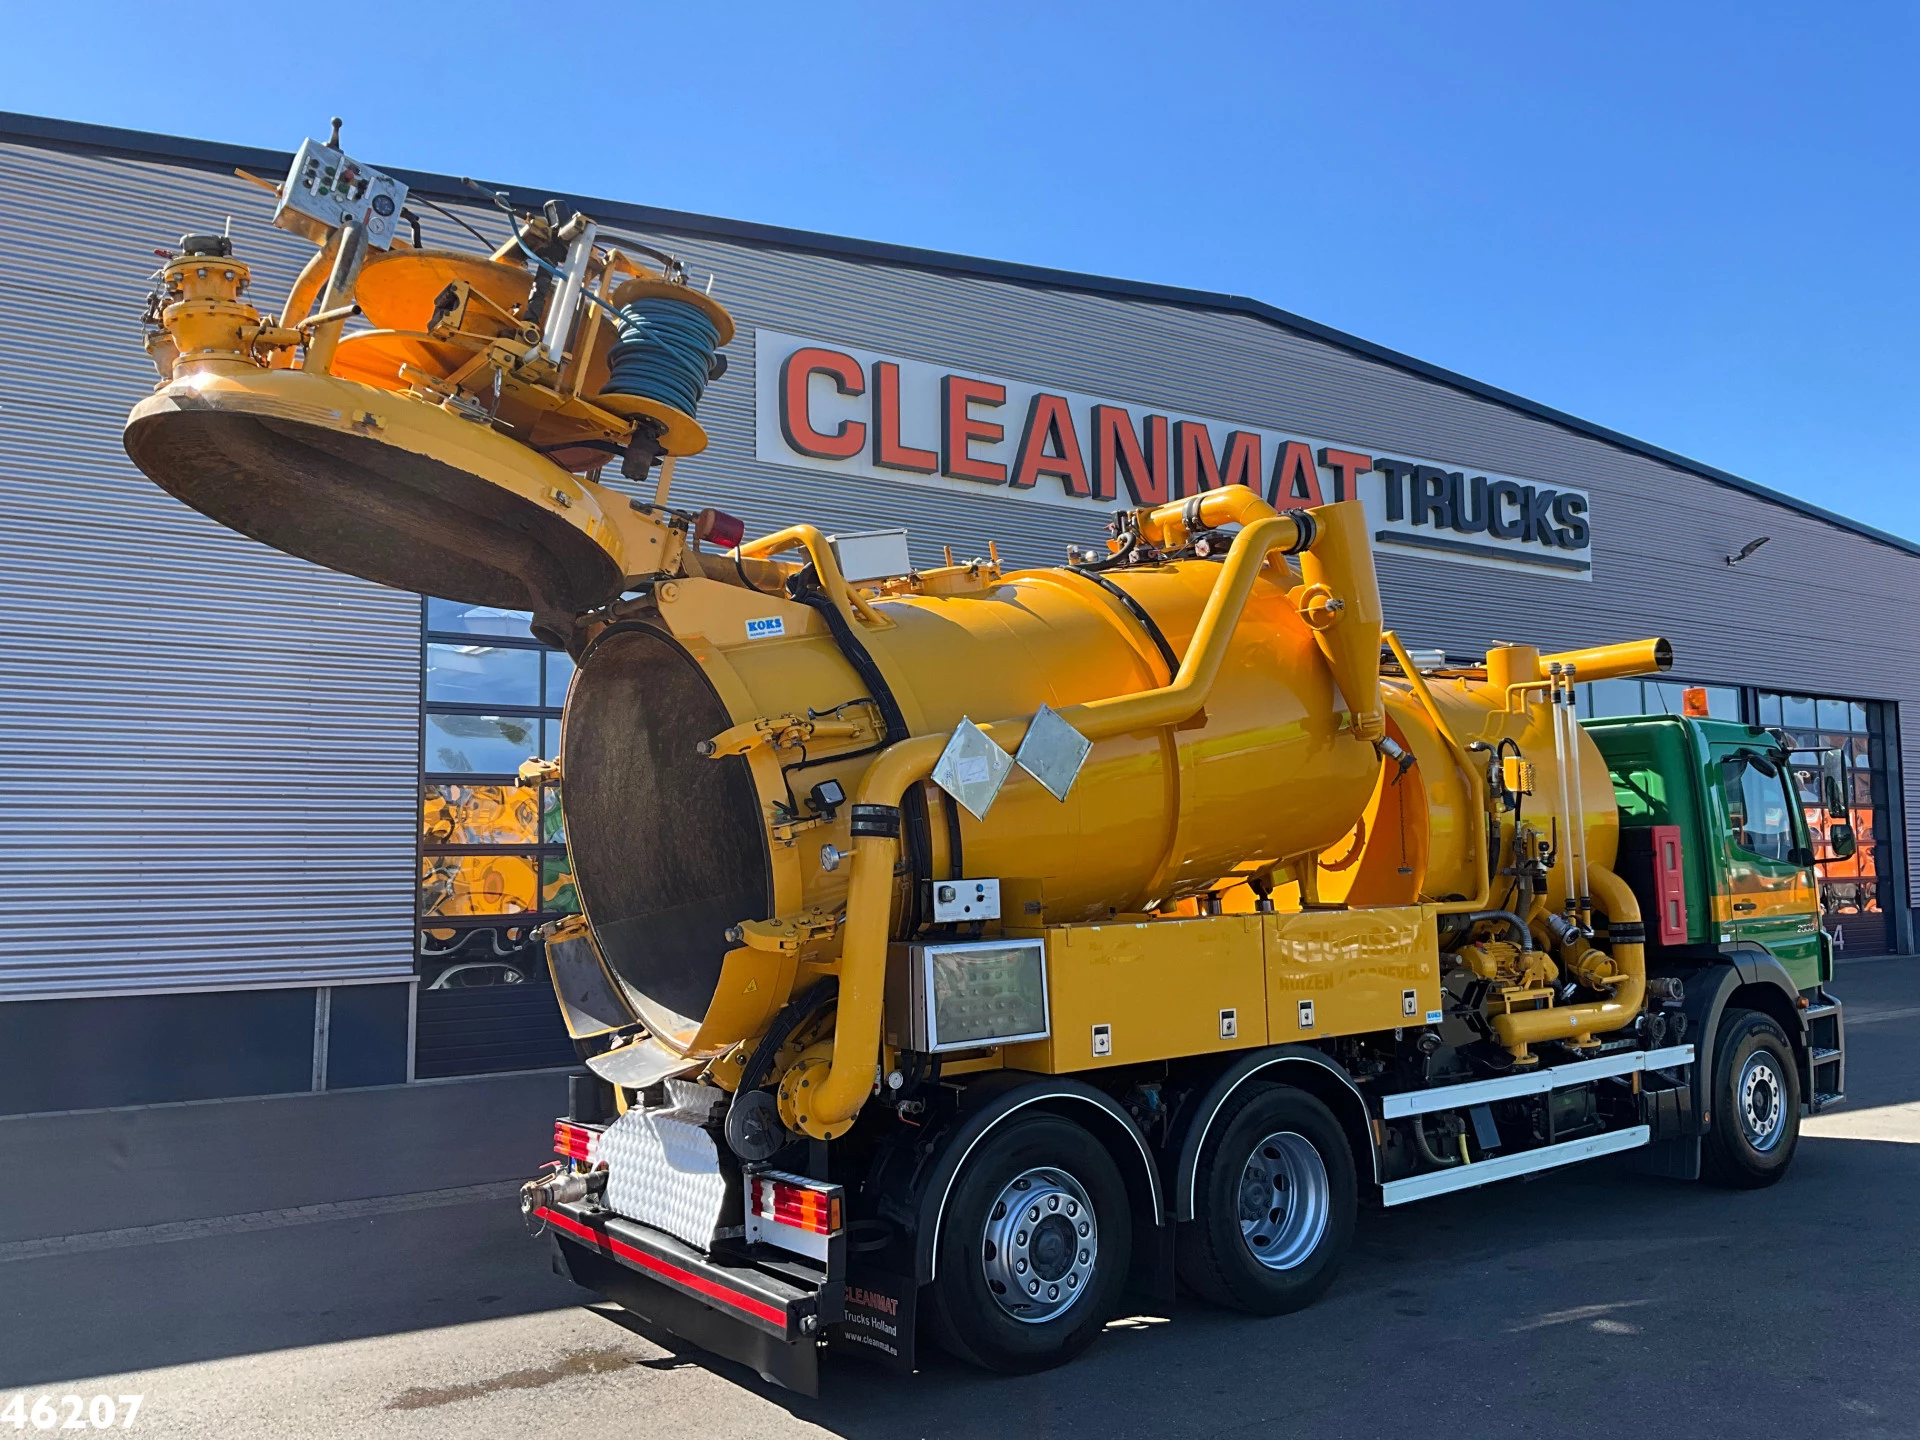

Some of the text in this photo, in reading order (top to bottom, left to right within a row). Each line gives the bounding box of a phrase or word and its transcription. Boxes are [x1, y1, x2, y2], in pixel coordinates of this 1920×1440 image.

[779, 347, 1590, 550] CLEANMAT TRUCKS
[747, 618, 782, 632] KOKS
[844, 1309, 897, 1337] Trucks Holland
